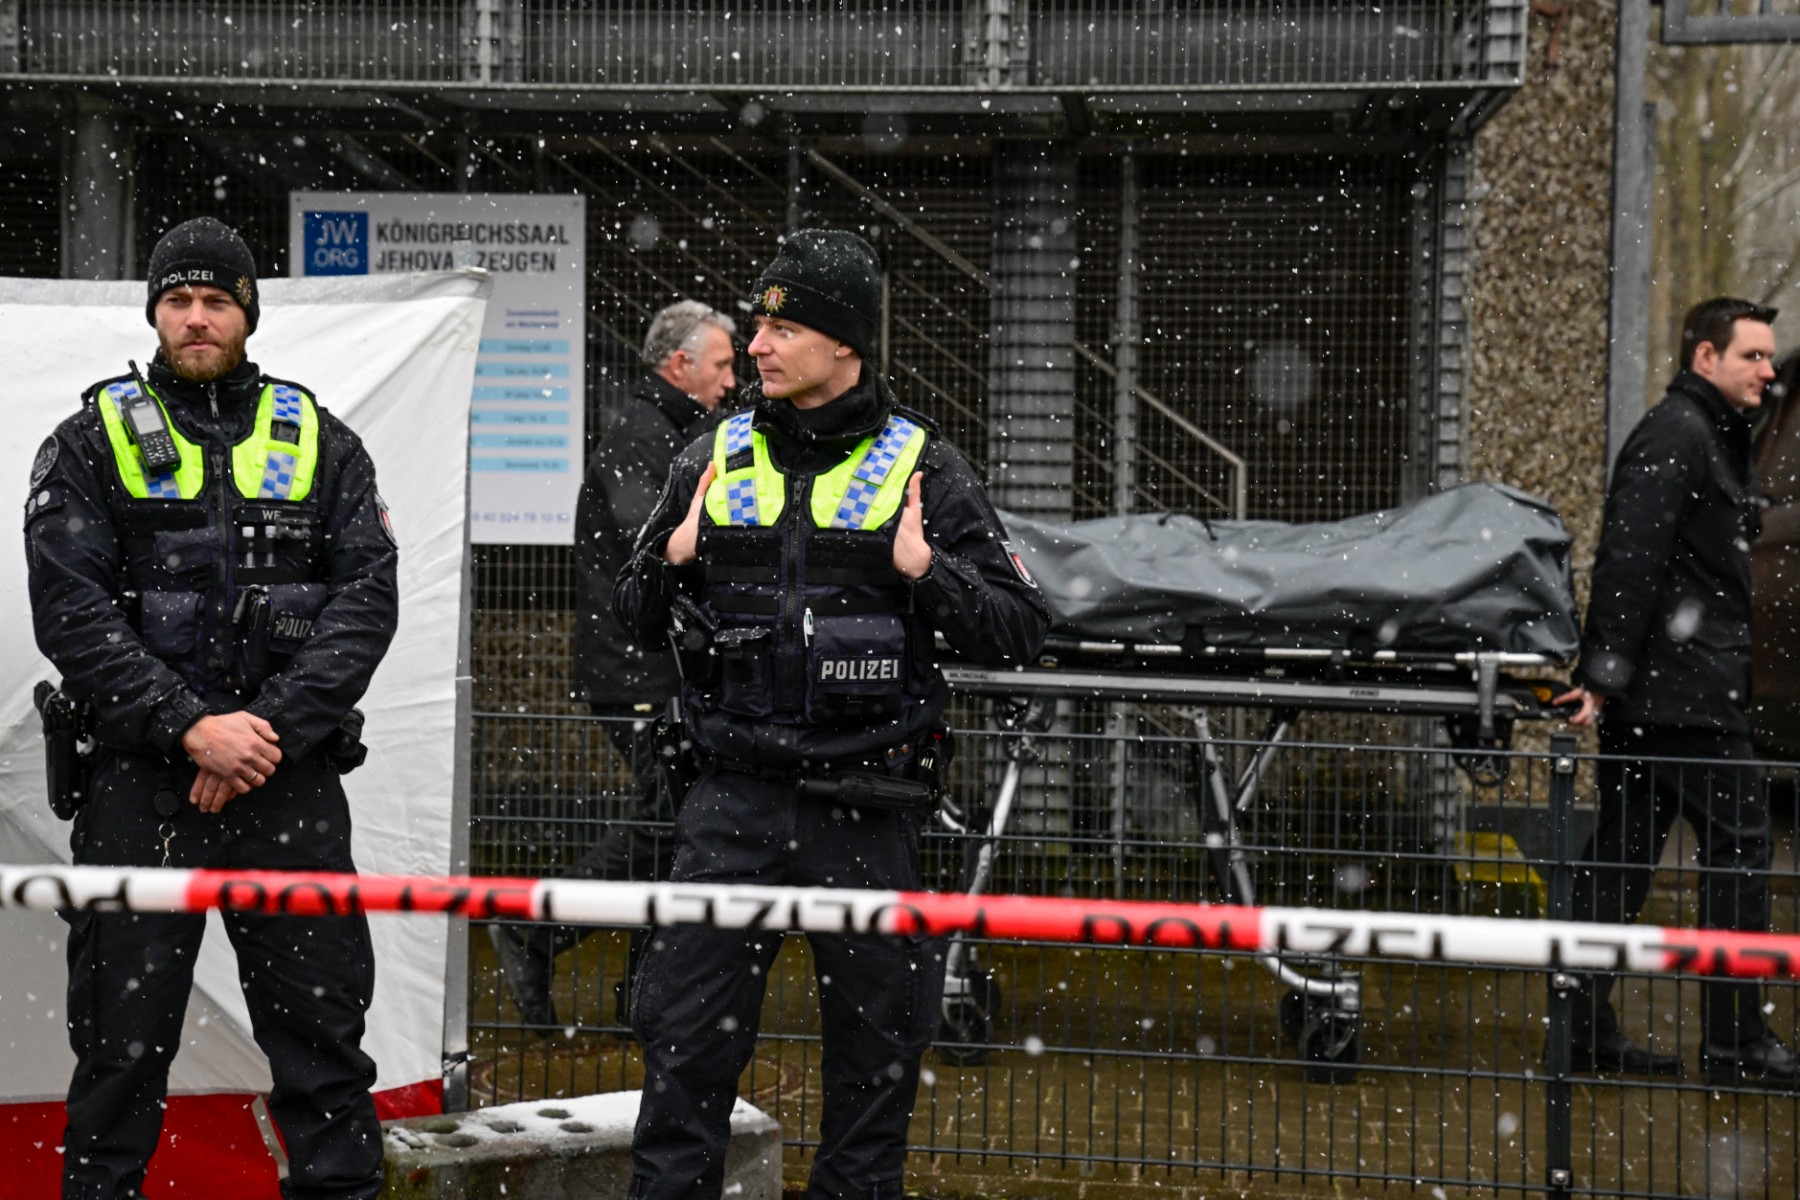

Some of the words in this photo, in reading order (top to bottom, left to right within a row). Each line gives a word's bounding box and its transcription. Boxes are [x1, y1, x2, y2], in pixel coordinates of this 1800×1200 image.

[316, 219, 358, 245] JW
[376, 218, 570, 244] KÖNIGREICHSSAAL
[314, 247, 359, 268] ORG
[375, 250, 456, 271] JEHOVA
[476, 251, 556, 273] ZEUGEN
[161, 270, 214, 288] POLIZEI
[821, 659, 899, 680] POLIZEI
